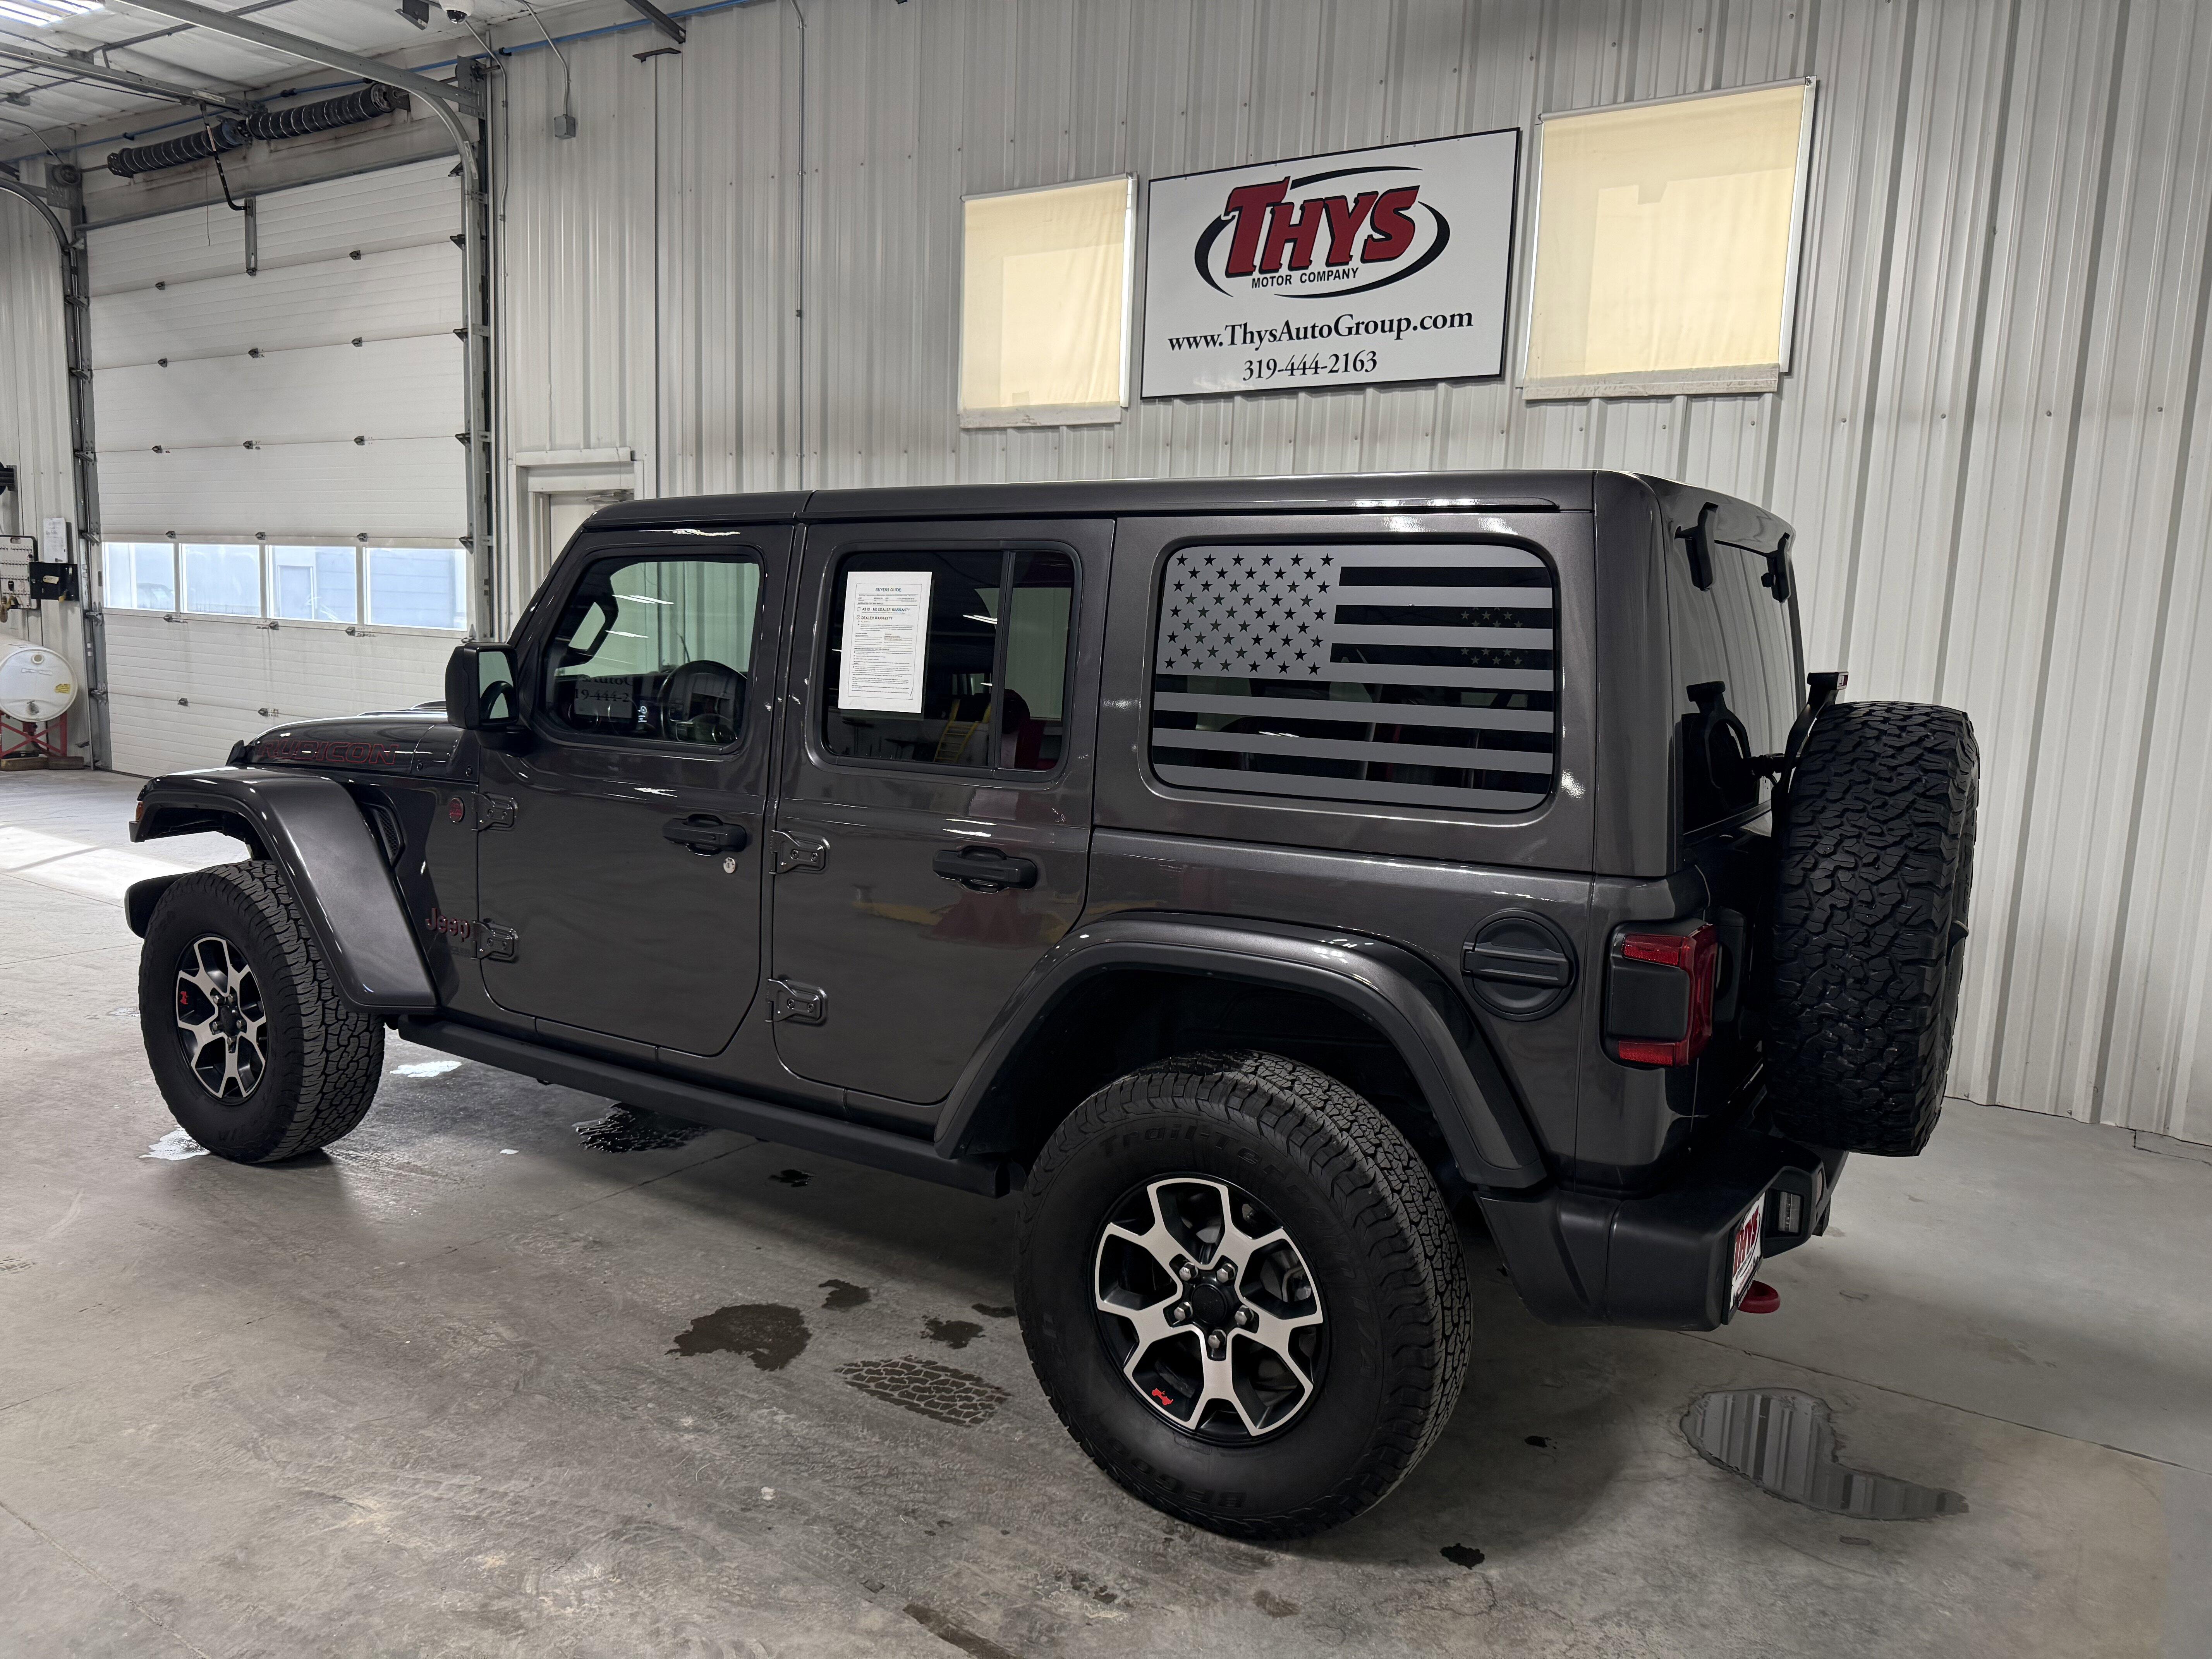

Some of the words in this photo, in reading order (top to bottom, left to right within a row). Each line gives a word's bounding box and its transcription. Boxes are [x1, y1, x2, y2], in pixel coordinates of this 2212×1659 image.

[1223, 176, 1420, 278] THYS
[1251, 274, 1292, 289] MOTOR
[1300, 267, 1359, 283] COMPANY
[1168, 311, 1474, 351] www.ThysAutoGroup.com
[1243, 350, 1378, 381] 319-444-2163
[258, 739, 399, 765] RUBICON
[425, 907, 470, 942] Jeep
